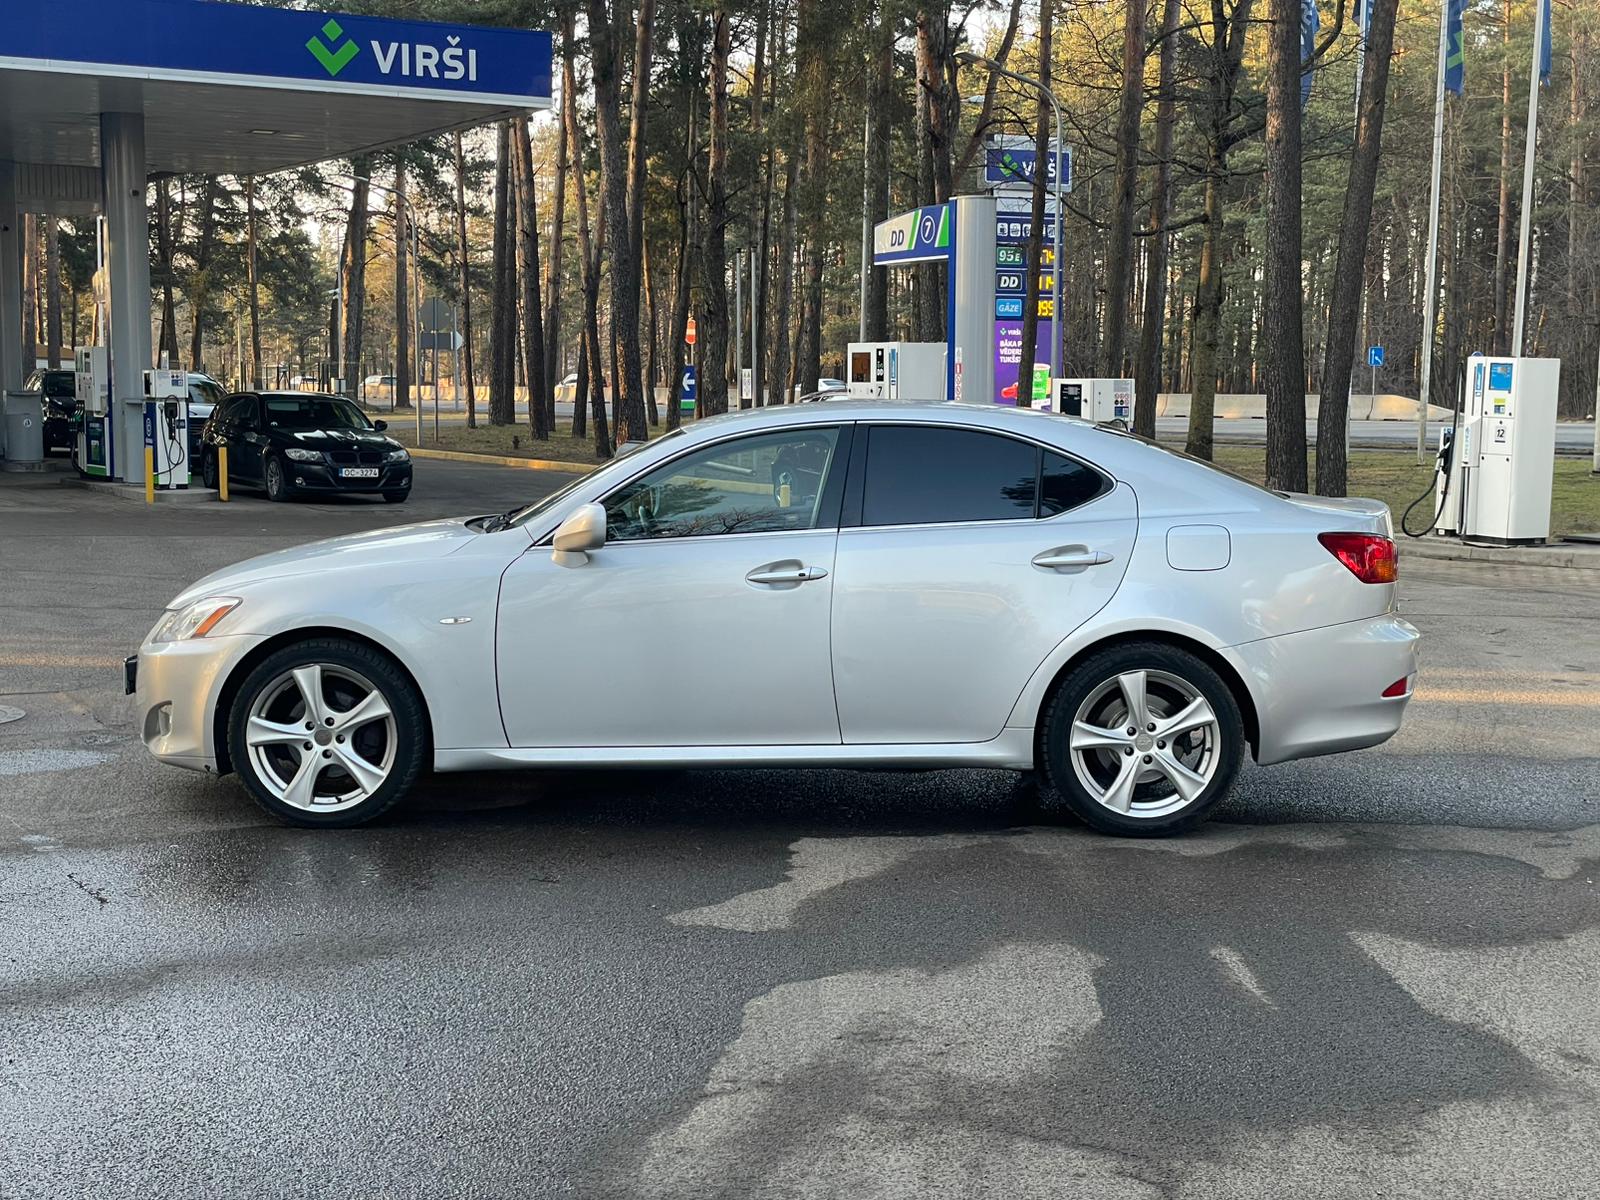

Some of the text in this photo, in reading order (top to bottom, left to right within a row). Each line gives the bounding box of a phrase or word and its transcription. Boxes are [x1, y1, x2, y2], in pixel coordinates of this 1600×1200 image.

[370, 35, 477, 82] VIRŠI
[924, 221, 931, 238] 7
[890, 229, 905, 248] DD
[999, 250, 1020, 262] 95E
[1000, 276, 1018, 288] DD
[998, 302, 1019, 313] GĀZE
[878, 386, 882, 396] 7
[1496, 429, 1505, 438] 12
[345, 469, 377, 477] OC-3274
